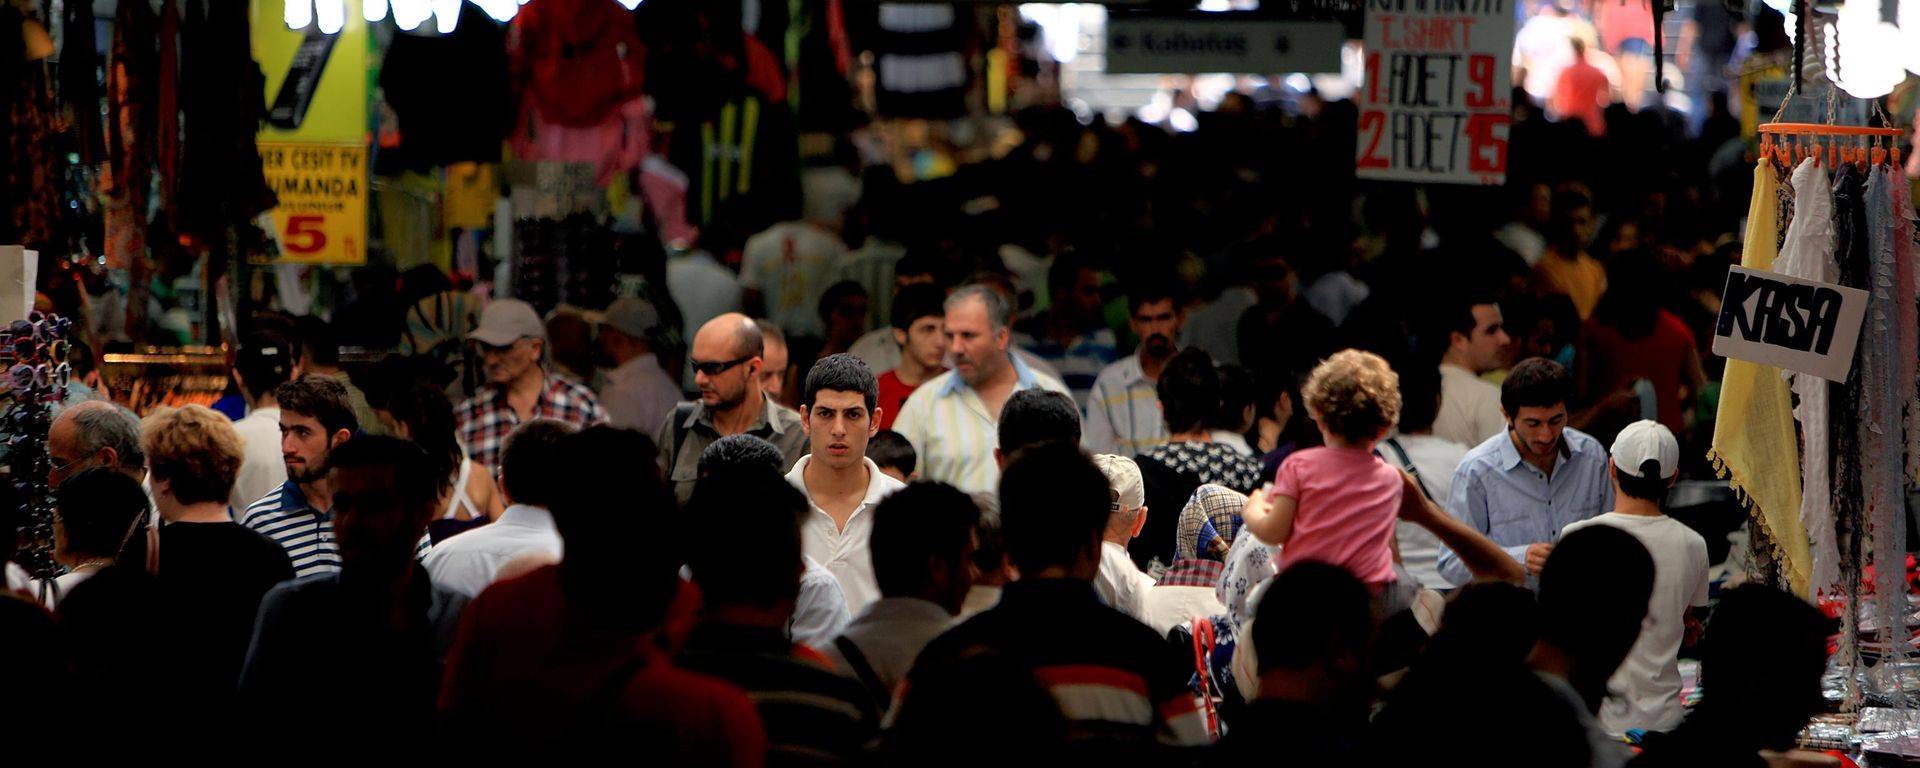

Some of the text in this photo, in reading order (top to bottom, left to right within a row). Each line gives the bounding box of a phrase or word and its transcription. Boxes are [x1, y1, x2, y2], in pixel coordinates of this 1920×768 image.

[1389, 53, 1463, 107] ADET
[1466, 55, 1496, 107] 9
[261, 150, 283, 168] ER
[341, 151, 360, 168] TV
[1355, 111, 1512, 173] 2 ADET 15
[266, 177, 359, 196] UMANDA
[286, 216, 326, 253] 5
[1716, 271, 1843, 355] KASA
